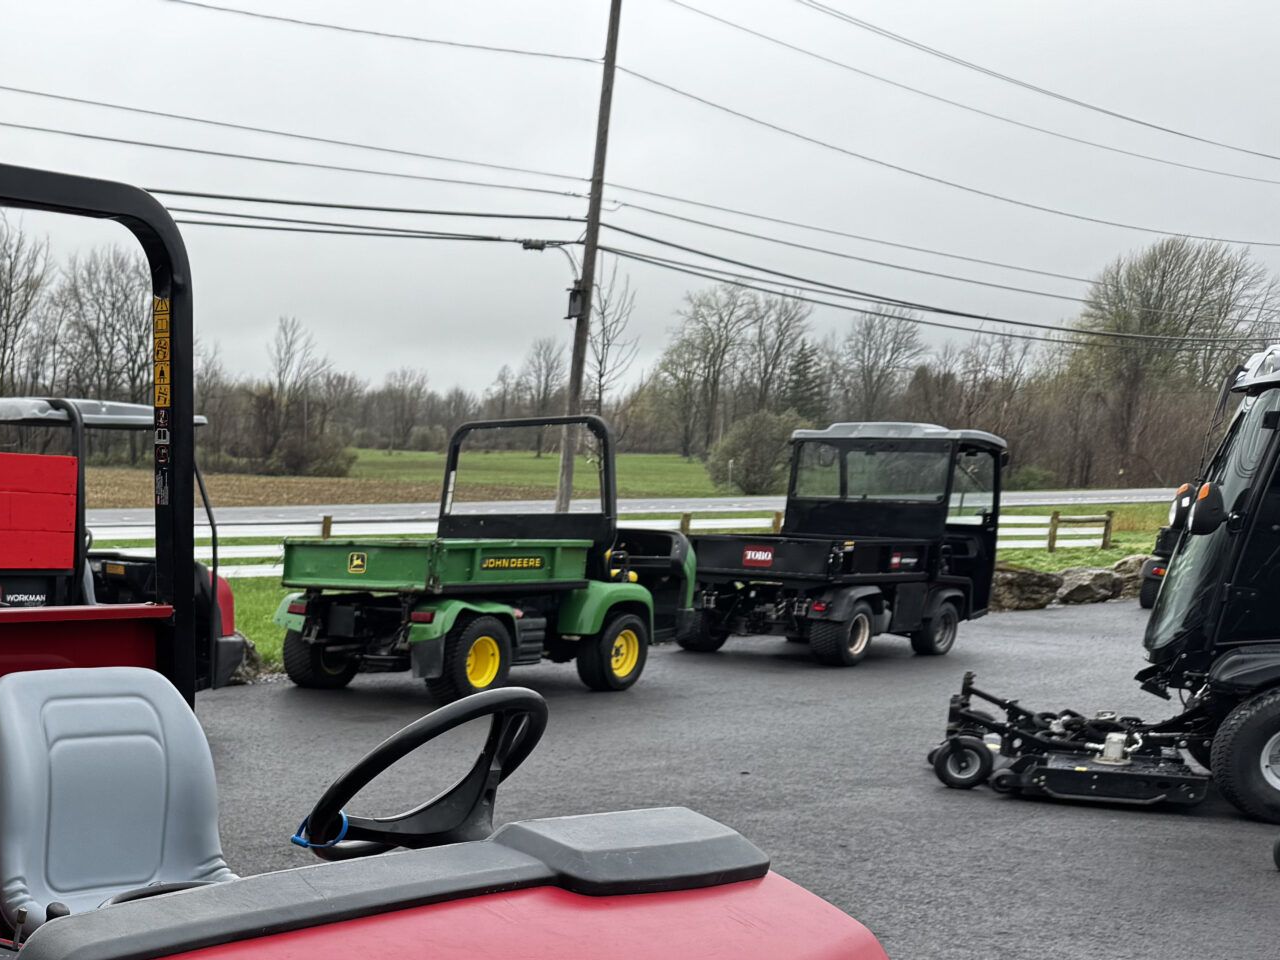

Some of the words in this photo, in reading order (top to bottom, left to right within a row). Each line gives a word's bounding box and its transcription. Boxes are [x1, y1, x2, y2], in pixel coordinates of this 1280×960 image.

[745, 550, 772, 560] TORO
[482, 558, 509, 568] JOHN
[510, 557, 541, 568] DEERE
